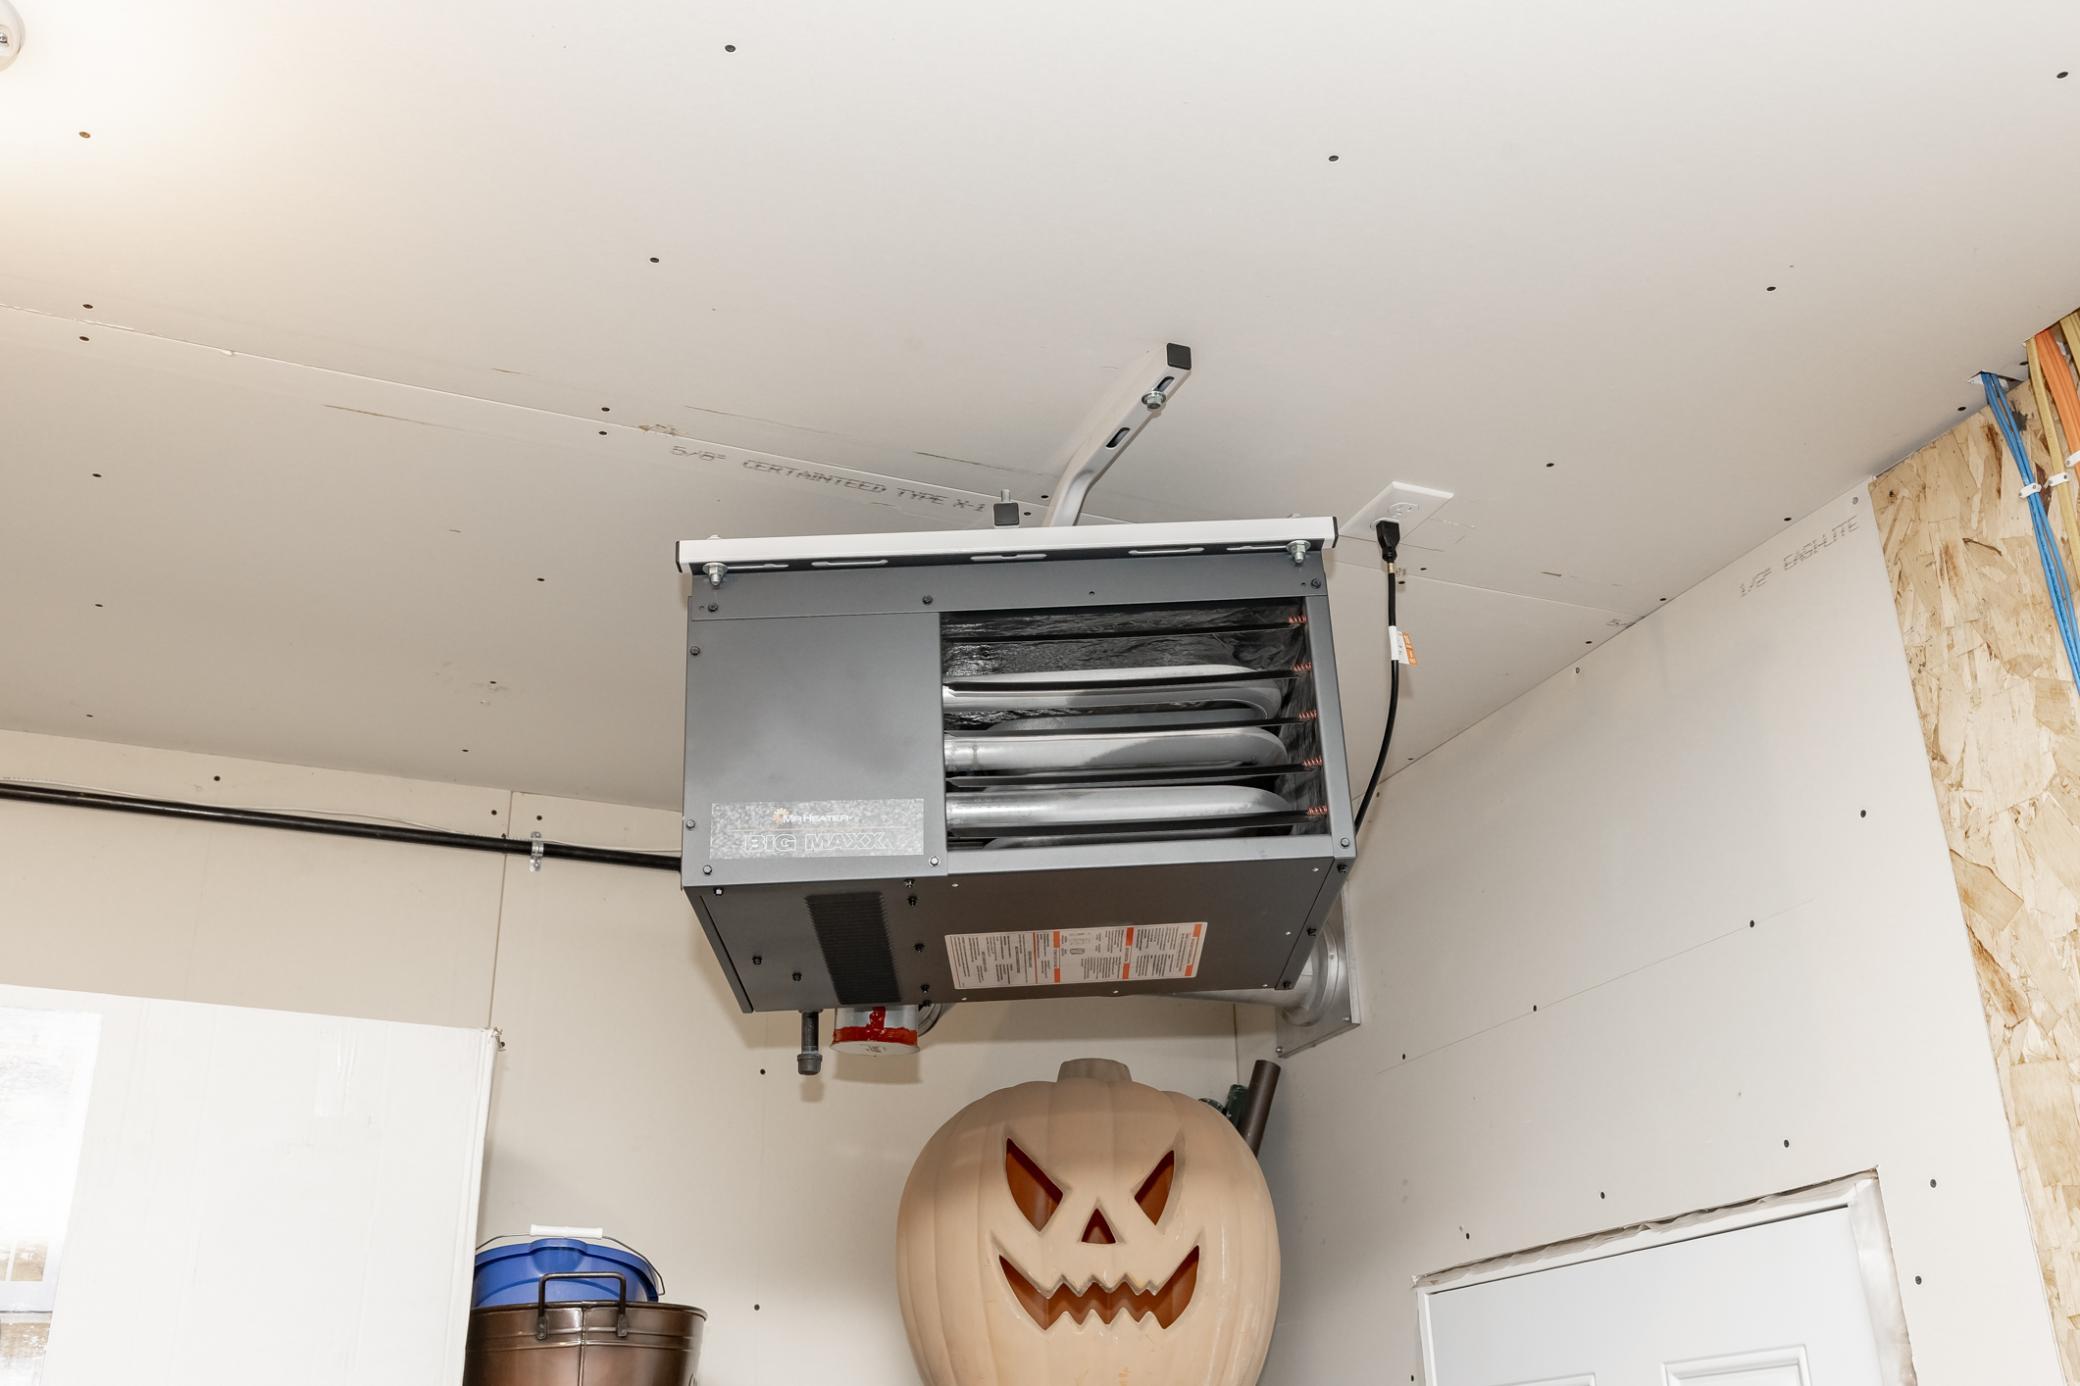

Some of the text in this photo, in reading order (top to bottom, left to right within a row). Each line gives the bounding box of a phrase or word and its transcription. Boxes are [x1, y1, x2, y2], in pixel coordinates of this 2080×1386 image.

[742, 458, 888, 494] CERTAINTEED
[895, 487, 946, 505] TYPE
[744, 831, 888, 852] BIG MAXX
